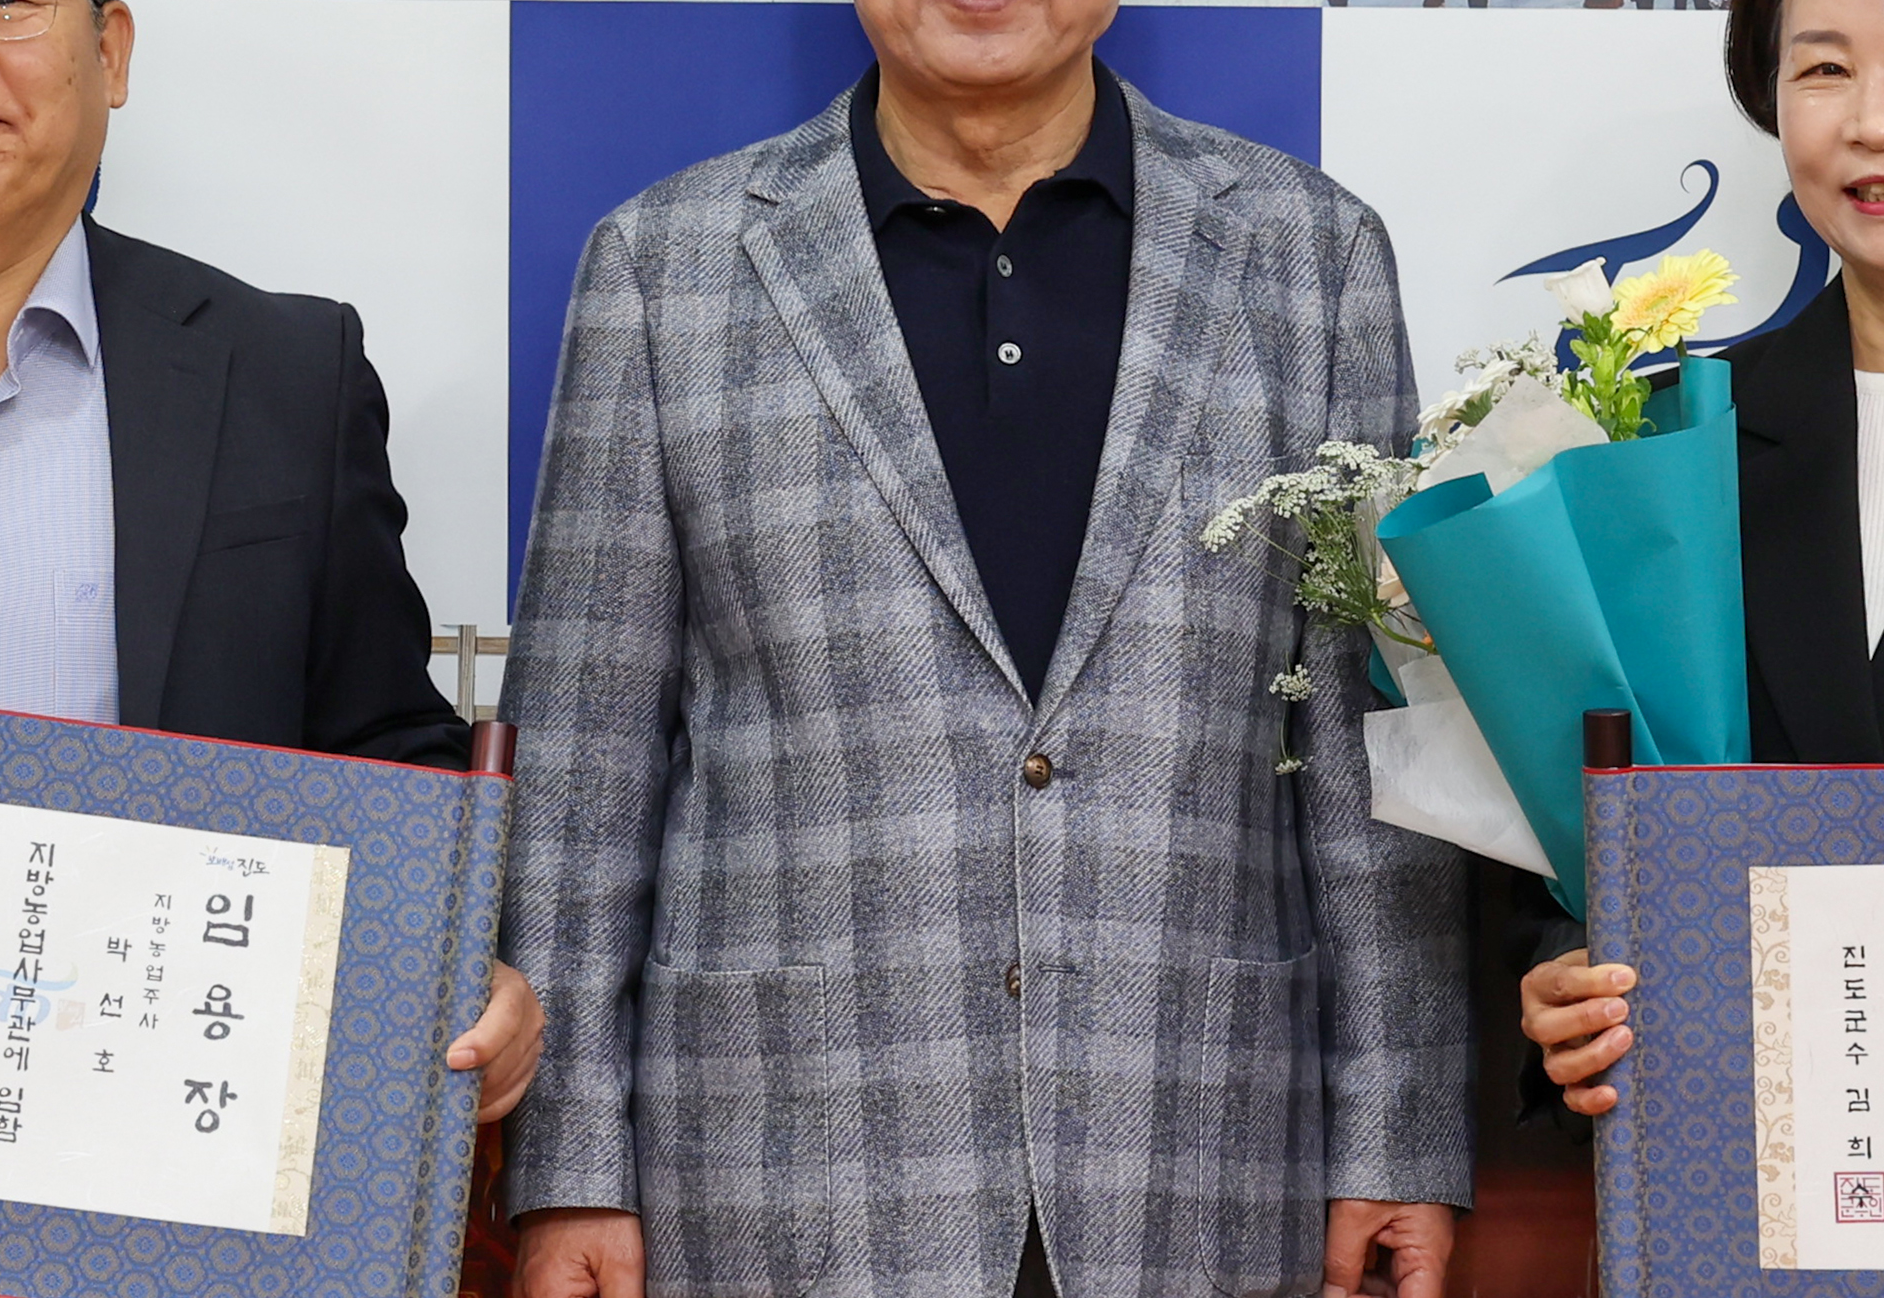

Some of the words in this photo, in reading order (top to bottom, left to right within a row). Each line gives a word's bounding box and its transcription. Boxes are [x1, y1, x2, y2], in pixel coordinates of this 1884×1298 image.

[236, 857, 271, 878] 진도
[3, 841, 55, 1072] 지방농업사무관에
[139, 894, 172, 1030] 지방농업주사
[1842, 944, 1869, 1066] 진도군수
